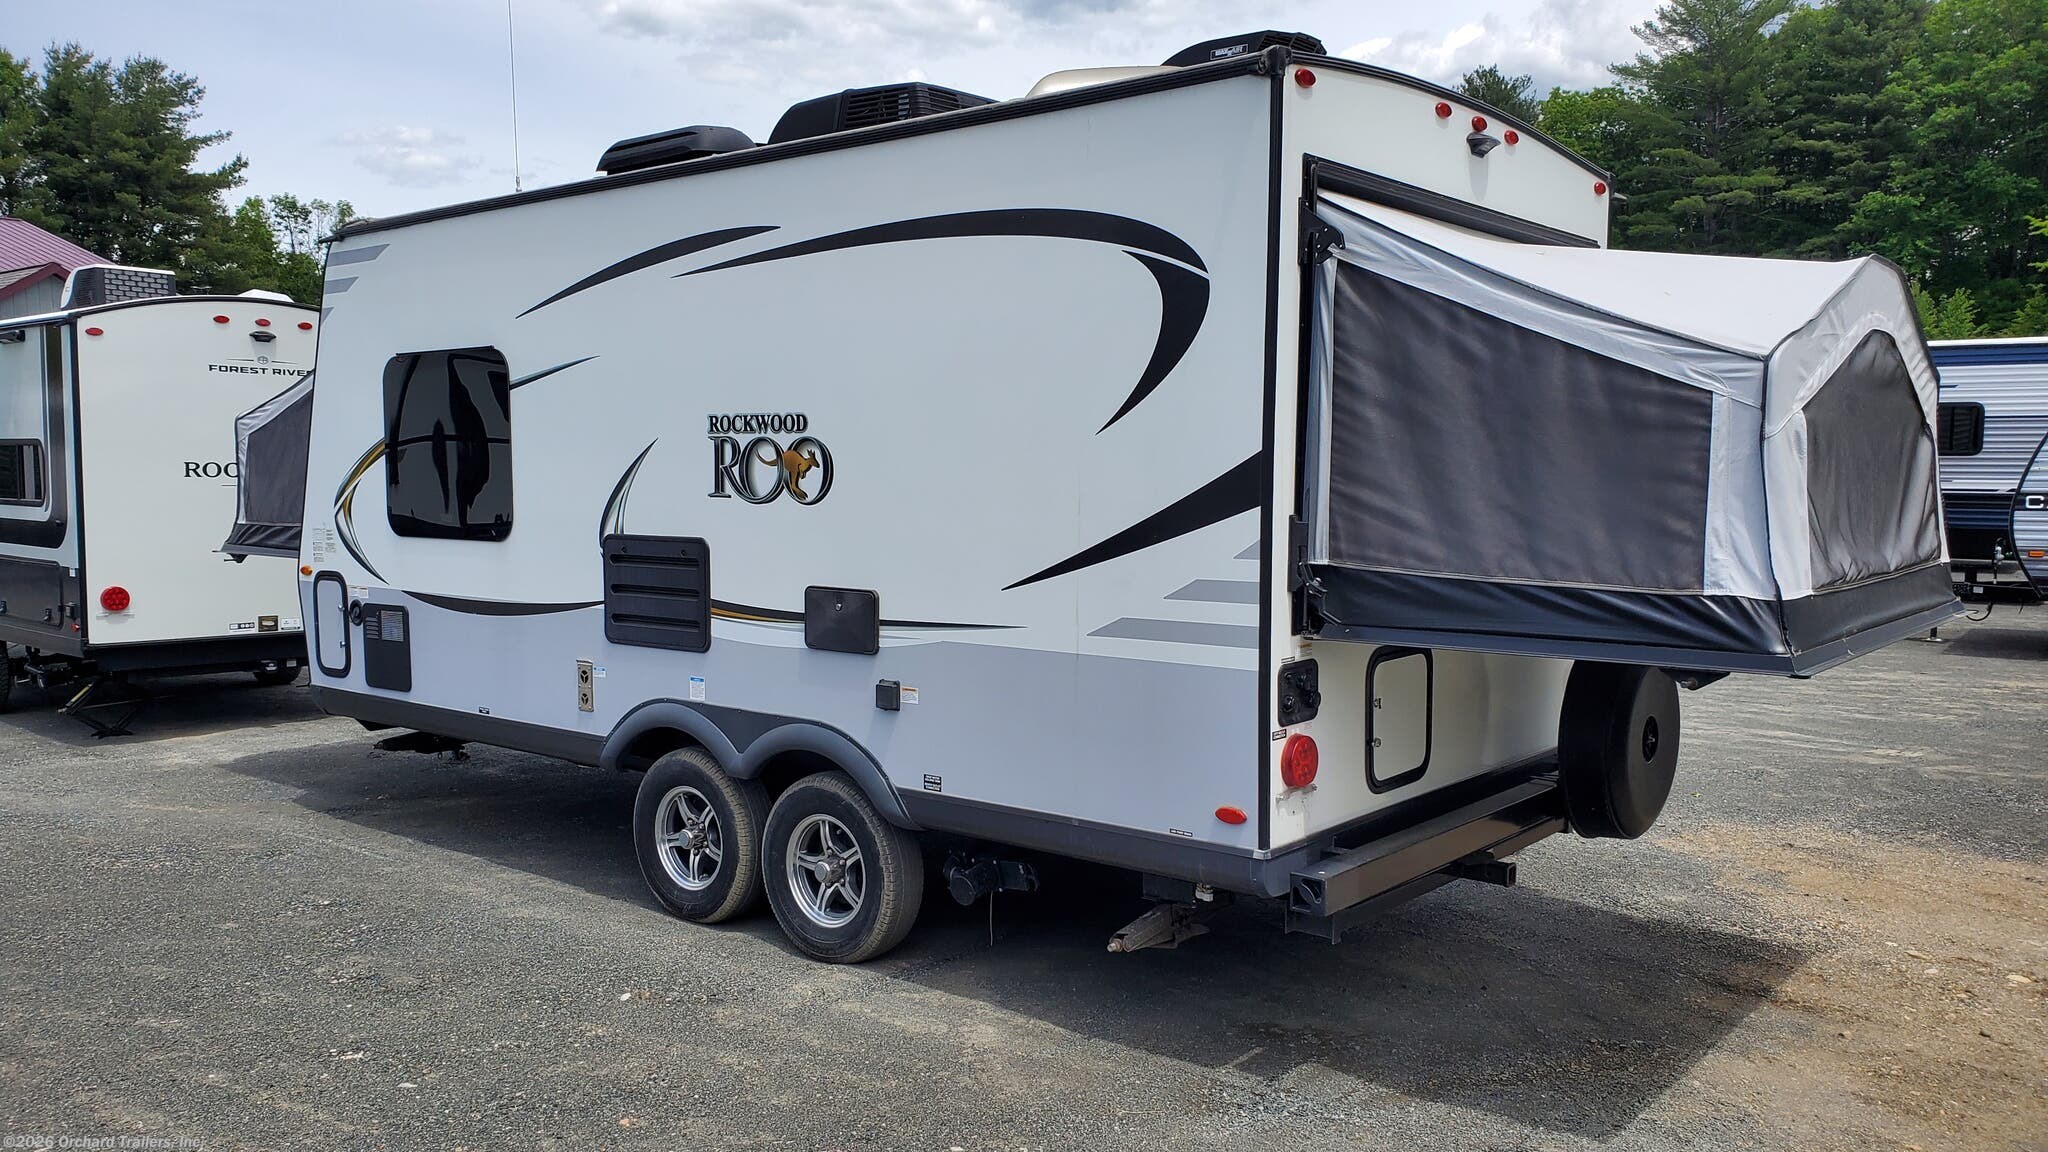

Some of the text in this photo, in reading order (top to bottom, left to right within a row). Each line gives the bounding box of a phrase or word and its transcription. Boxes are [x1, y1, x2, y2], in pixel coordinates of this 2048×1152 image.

[208, 364, 269, 375] FOREST
[707, 413, 809, 434] ROCKWOOD
[707, 435, 834, 506] ROO
[2025, 495, 2048, 509] C
